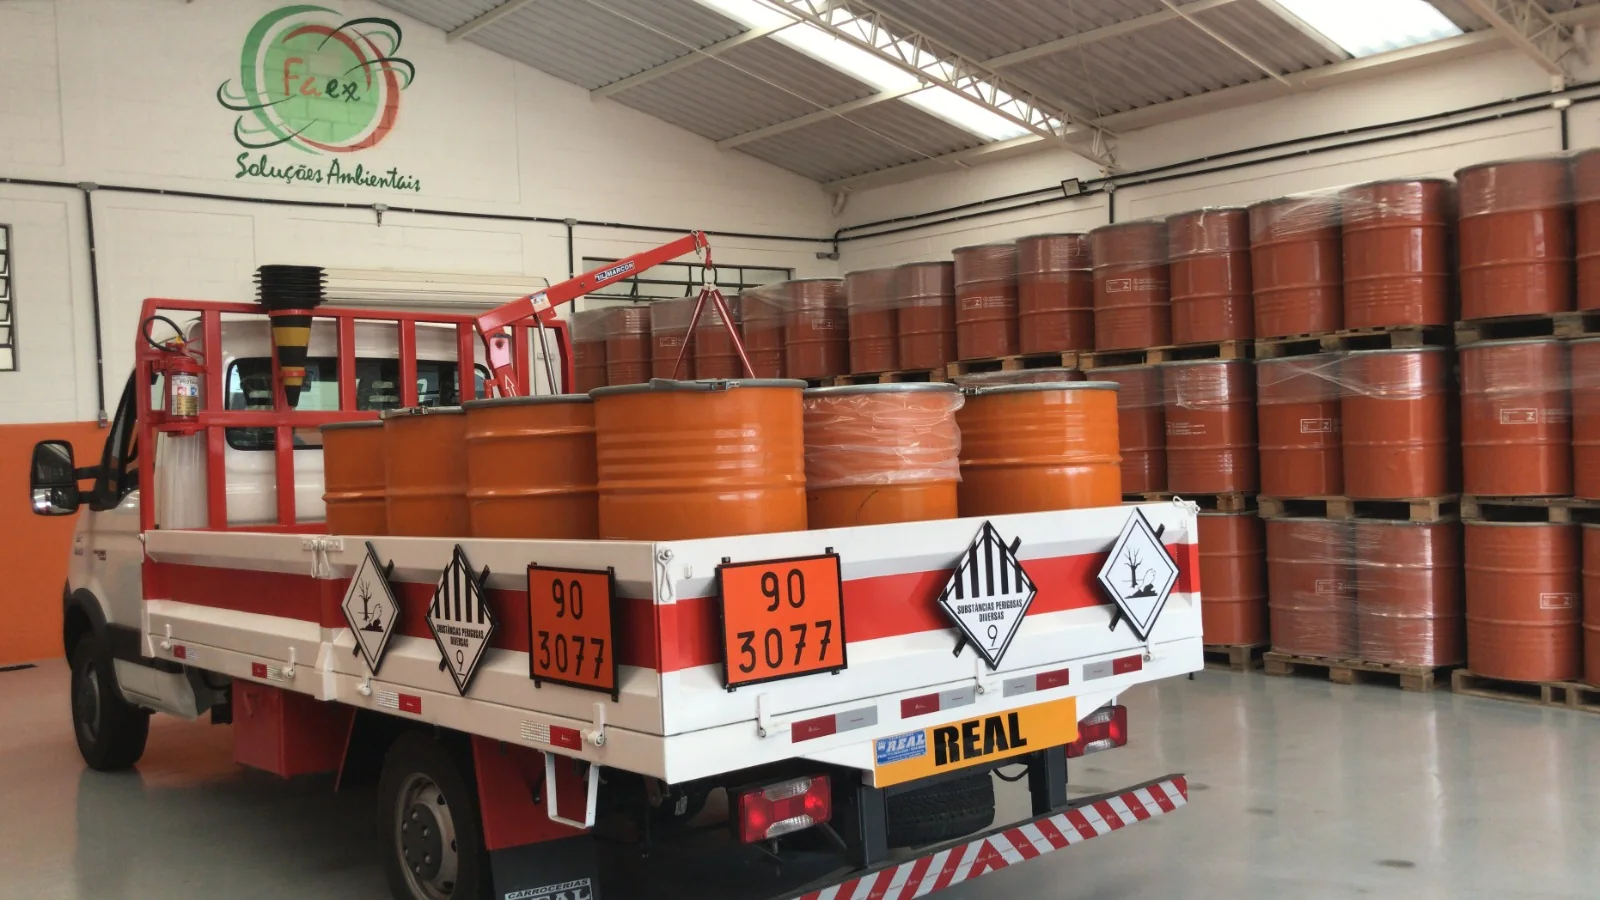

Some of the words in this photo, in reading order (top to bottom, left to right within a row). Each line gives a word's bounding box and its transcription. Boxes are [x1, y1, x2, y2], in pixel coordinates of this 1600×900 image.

[282, 57, 361, 103] Faex
[235, 152, 324, 184] Soluções
[327, 158, 421, 192] Ambientais
[552, 578, 584, 621] 90
[761, 568, 805, 612] 90
[995, 598, 1023, 610] PERIGOSAS
[979, 610, 1005, 622] DIVERSAS
[987, 624, 998, 647] 9
[456, 649, 464, 672] 9
[537, 630, 605, 679] 3077
[737, 620, 832, 674] 3077
[886, 733, 926, 753] REAL
[933, 711, 1028, 767] REAL
[507, 879, 589, 899] CARROCERIAS
